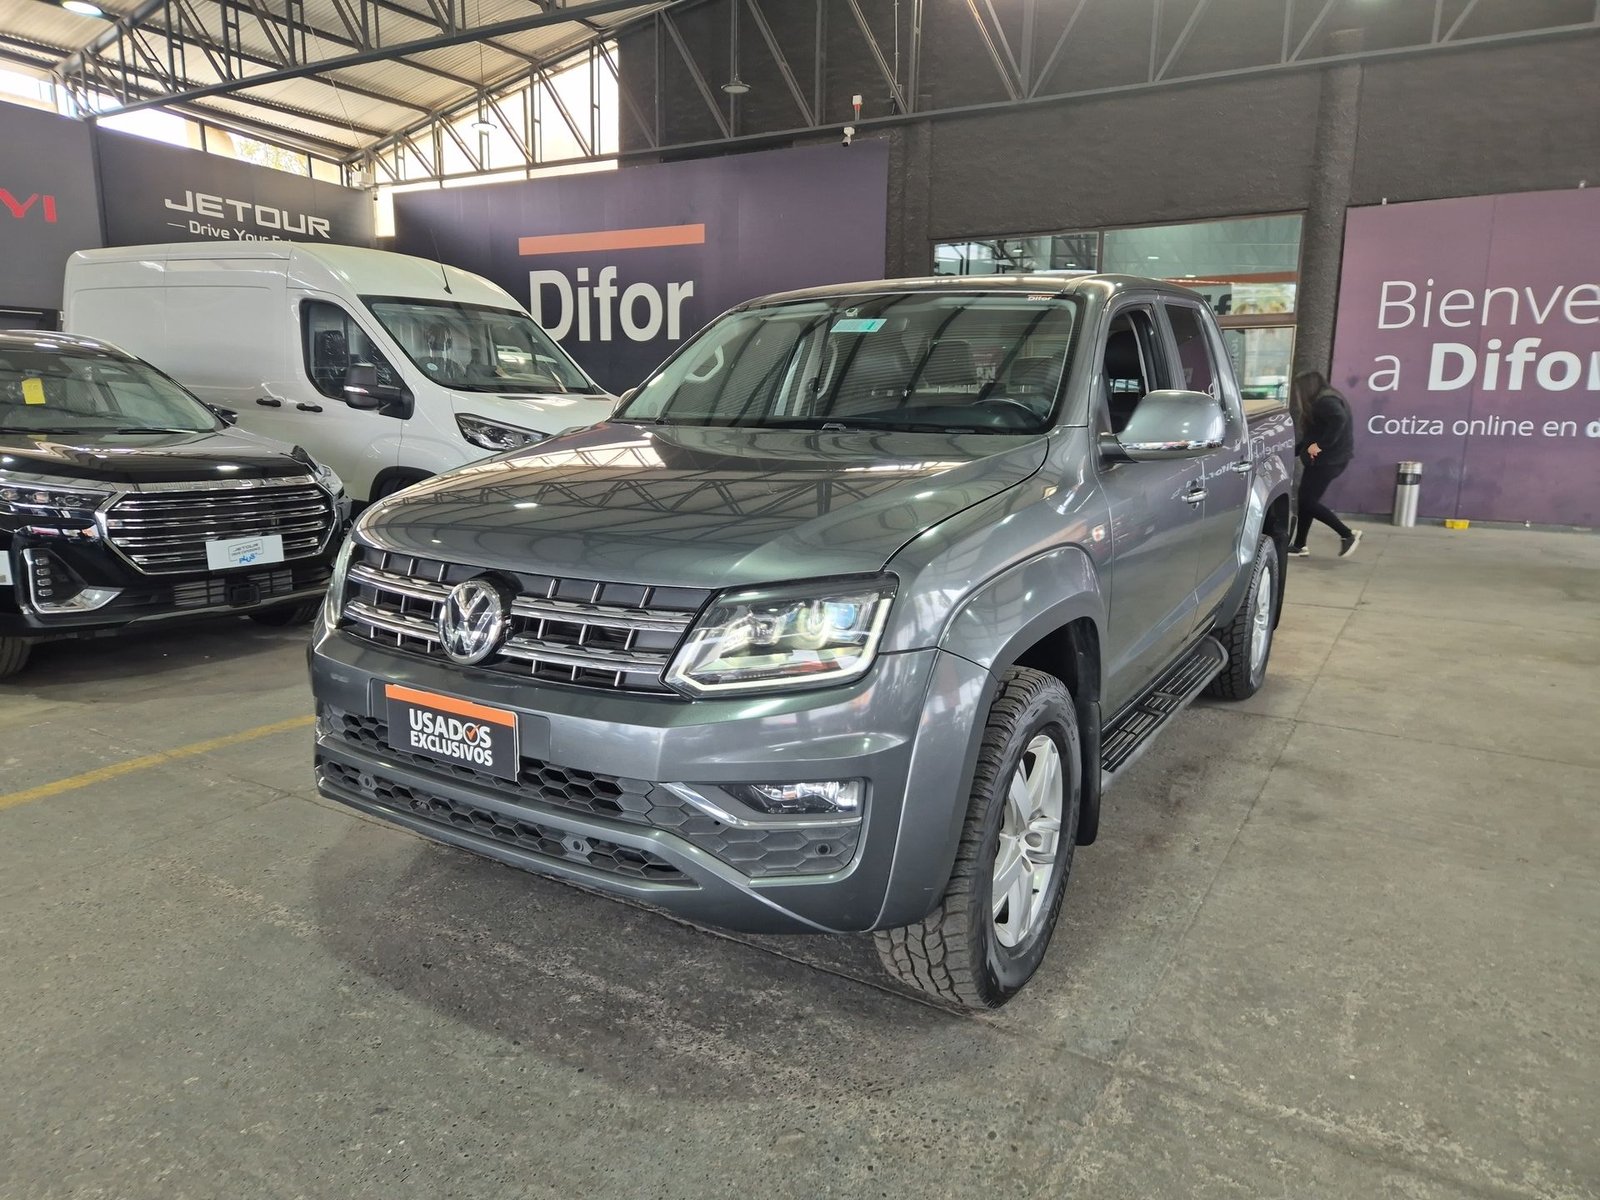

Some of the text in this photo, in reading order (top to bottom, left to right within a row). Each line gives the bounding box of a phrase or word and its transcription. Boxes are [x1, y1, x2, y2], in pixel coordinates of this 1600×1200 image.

[164, 190, 332, 239] JETOUR
[189, 220, 230, 239] Drive
[529, 265, 694, 342] Difor
[1377, 278, 1600, 329] Bienve
[1367, 354, 1401, 392] a
[1367, 415, 1443, 436] Cotiza
[1452, 415, 1534, 437] online
[1543, 420, 1577, 437] en
[409, 708, 492, 748] USADOS
[410, 730, 493, 766] EXCLUSIVOS
